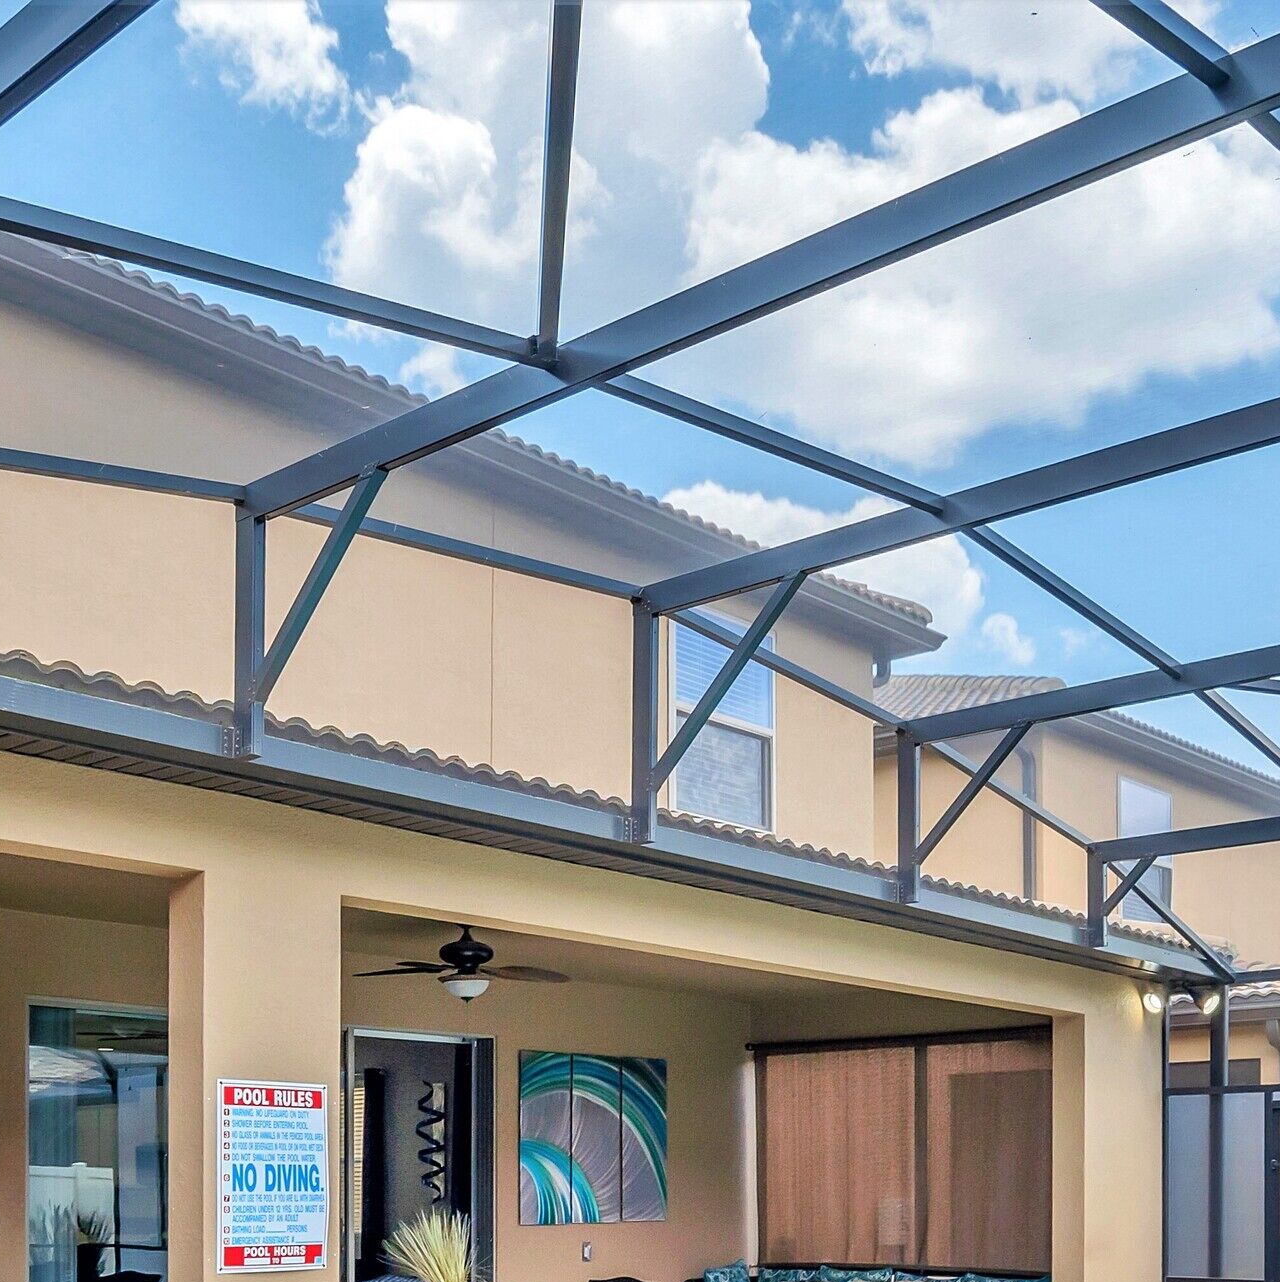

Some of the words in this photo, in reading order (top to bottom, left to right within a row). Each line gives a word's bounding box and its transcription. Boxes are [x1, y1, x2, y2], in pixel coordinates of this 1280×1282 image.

[233, 1088, 270, 1106] POOL
[273, 1089, 314, 1108] RULES
[264, 1110, 288, 1118] LIFEGUARD
[290, 1110, 296, 1118] ON
[232, 1120, 252, 1128] SHOWER
[254, 1120, 272, 1128] BEFORE
[273, 1121, 295, 1129] ENTERING
[296, 1121, 308, 1129] POOL
[277, 1154, 286, 1162] THE
[287, 1154, 299, 1162] POOL
[232, 1163, 257, 1192] NO
[265, 1164, 324, 1192] DIVING.
[232, 1205, 256, 1213] CHILDREN
[258, 1205, 274, 1213] UNDER
[294, 1205, 304, 1213] OLD
[305, 1205, 317, 1213] MUST
[319, 1205, 325, 1213] BE
[276, 1214, 283, 1222] AN
[285, 1214, 299, 1222] ADULT
[287, 1225, 308, 1233] PERSONS
[262, 1236, 289, 1244] ASSISTANCE
[244, 1246, 270, 1257] POOL
[273, 1245, 306, 1256] HOURS
